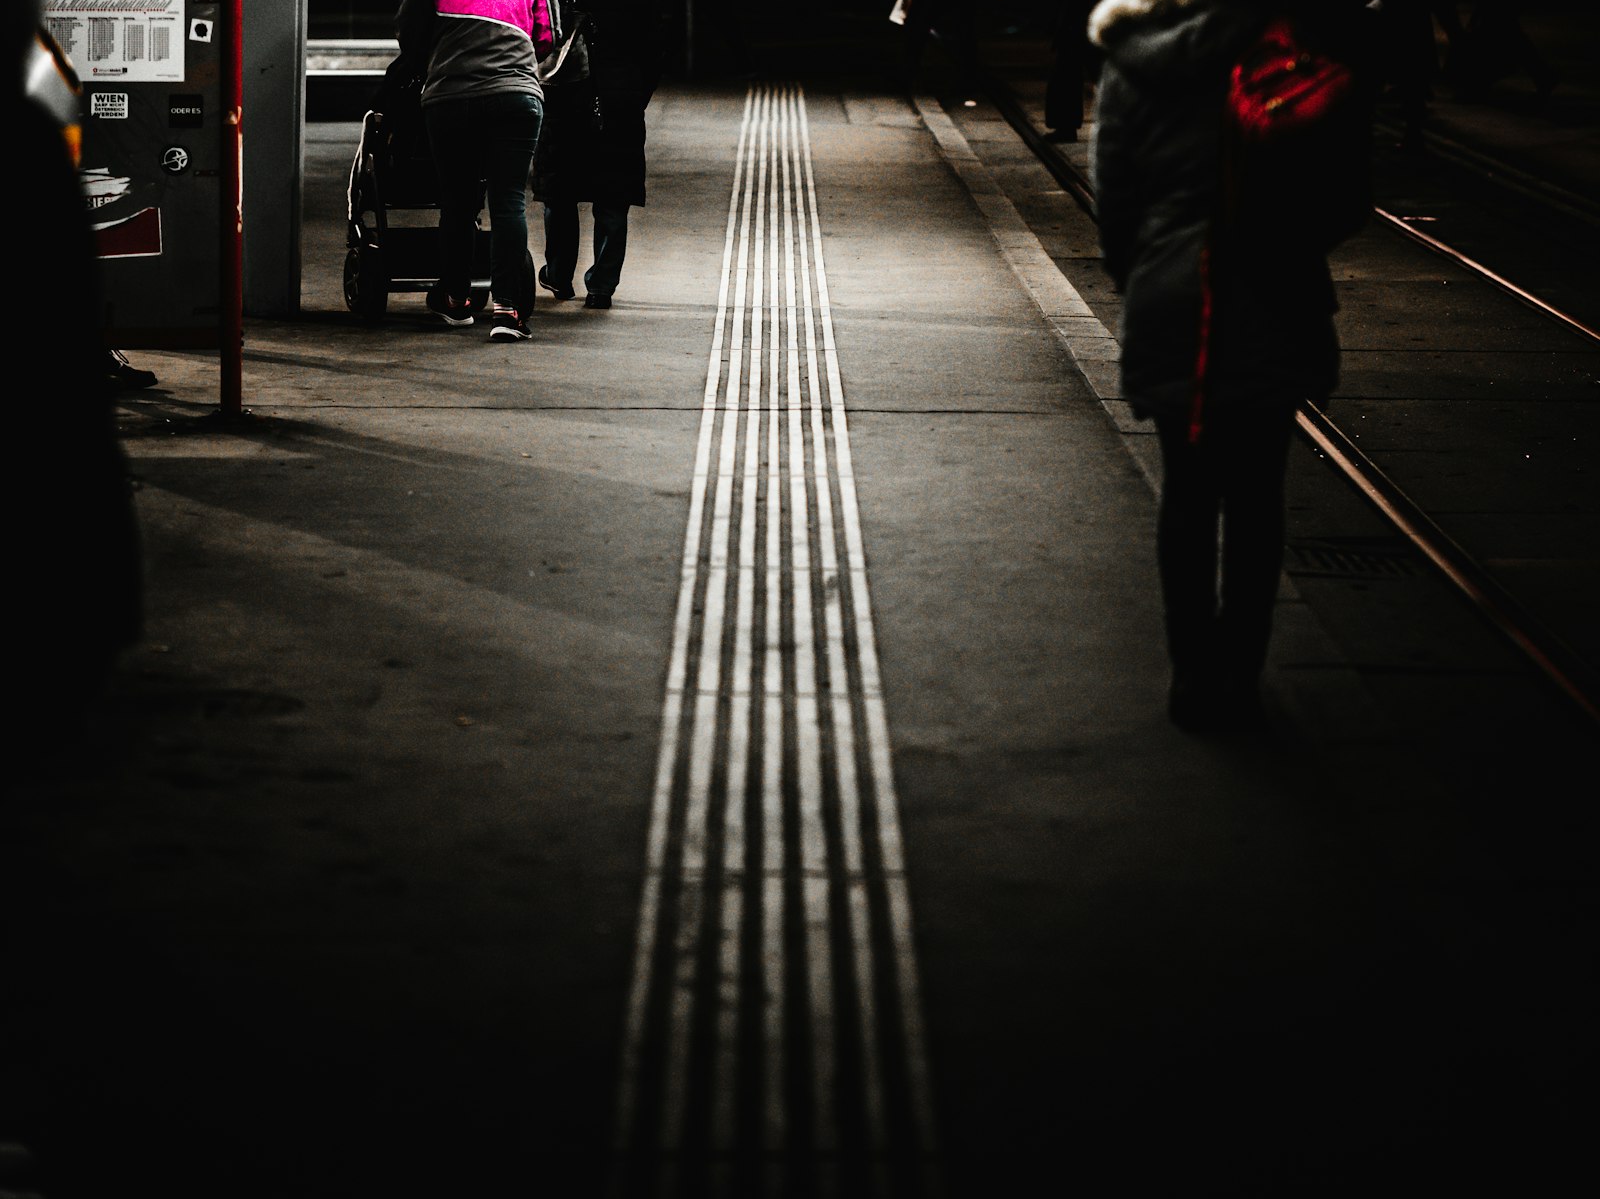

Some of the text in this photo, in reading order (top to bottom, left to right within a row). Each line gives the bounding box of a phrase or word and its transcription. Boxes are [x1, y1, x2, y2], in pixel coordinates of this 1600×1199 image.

[94, 94, 125, 103] WIEN
[170, 107, 202, 115] ODER ES
